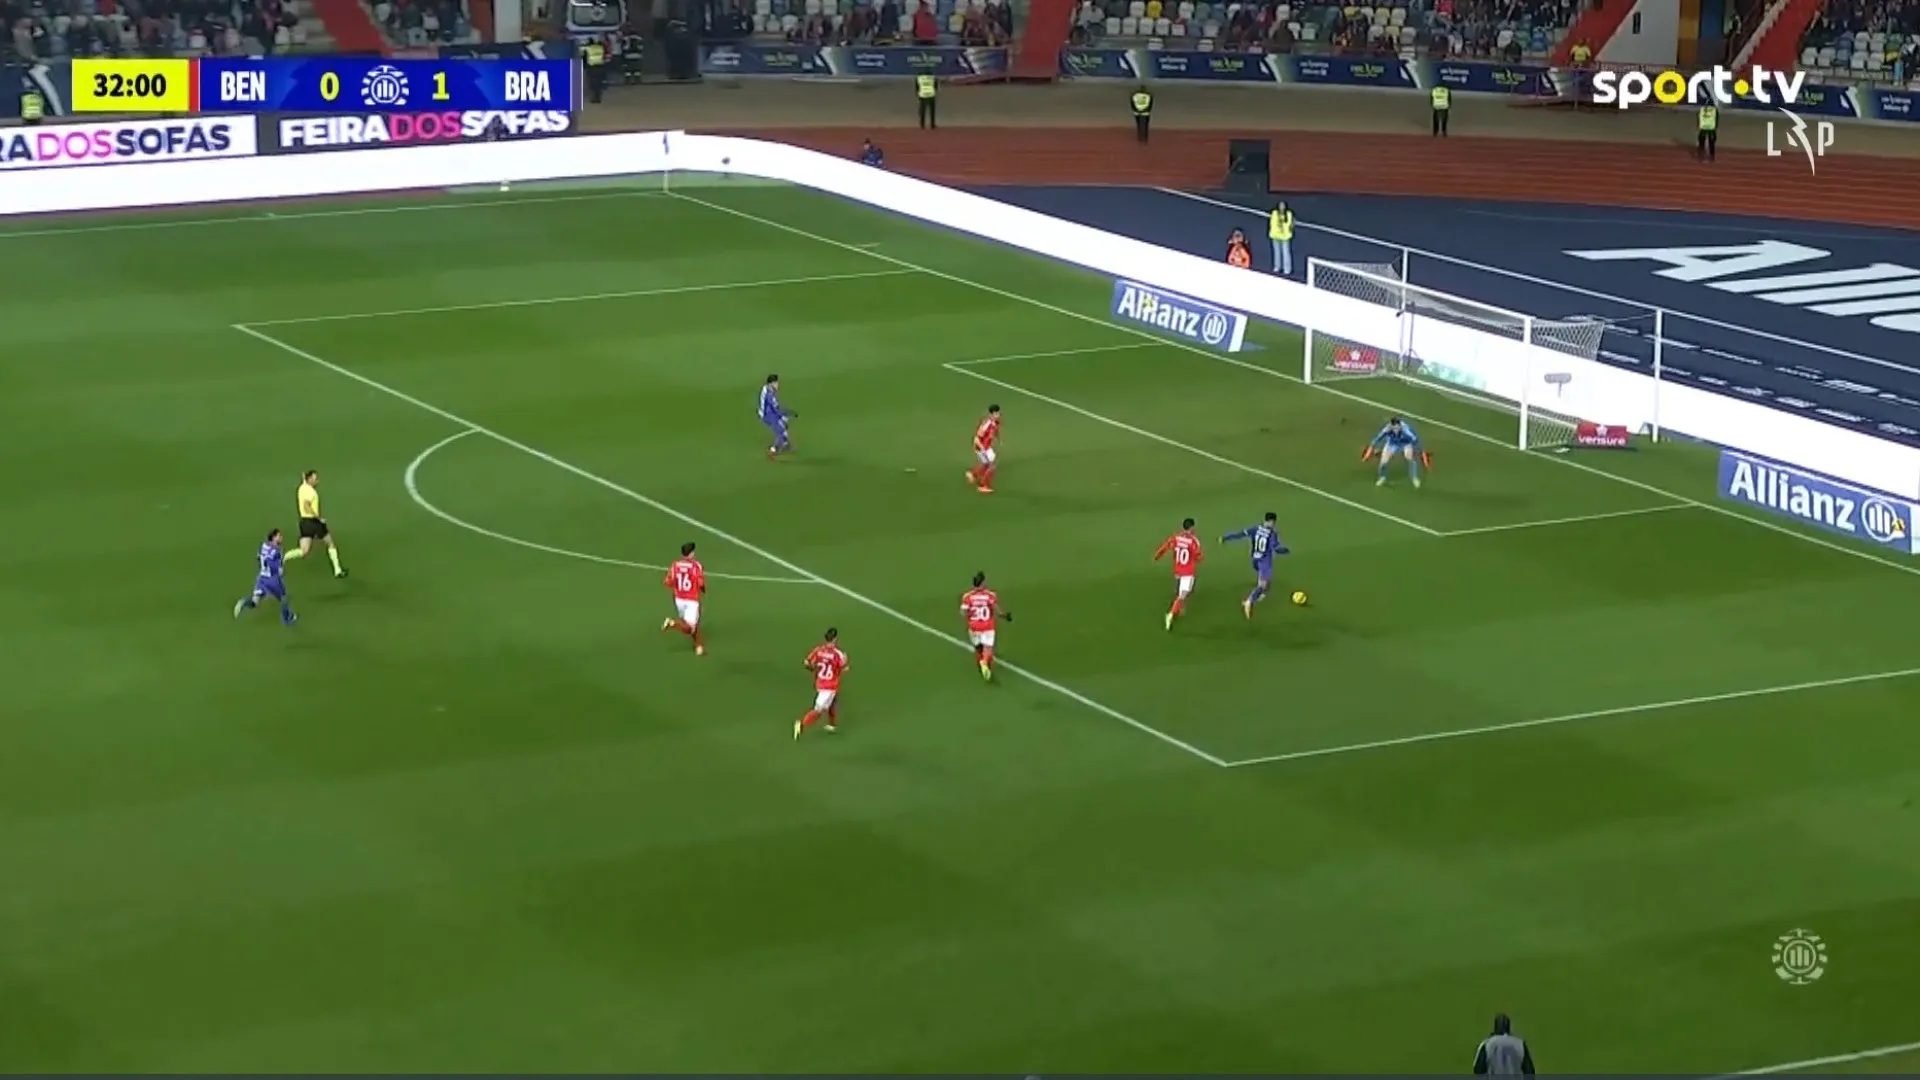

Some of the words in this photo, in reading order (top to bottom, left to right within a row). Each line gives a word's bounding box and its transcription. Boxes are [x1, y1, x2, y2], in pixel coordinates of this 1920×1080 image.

[1117, 286, 1198, 337] Allianz
[1578, 435, 1626, 447] verisure
[1729, 460, 1855, 533] Allianz
[1255, 533, 1268, 552] 10
[1174, 547, 1190, 565] 10
[676, 573, 692, 592] 16
[969, 606, 990, 621] 30
[817, 662, 834, 680] 26
